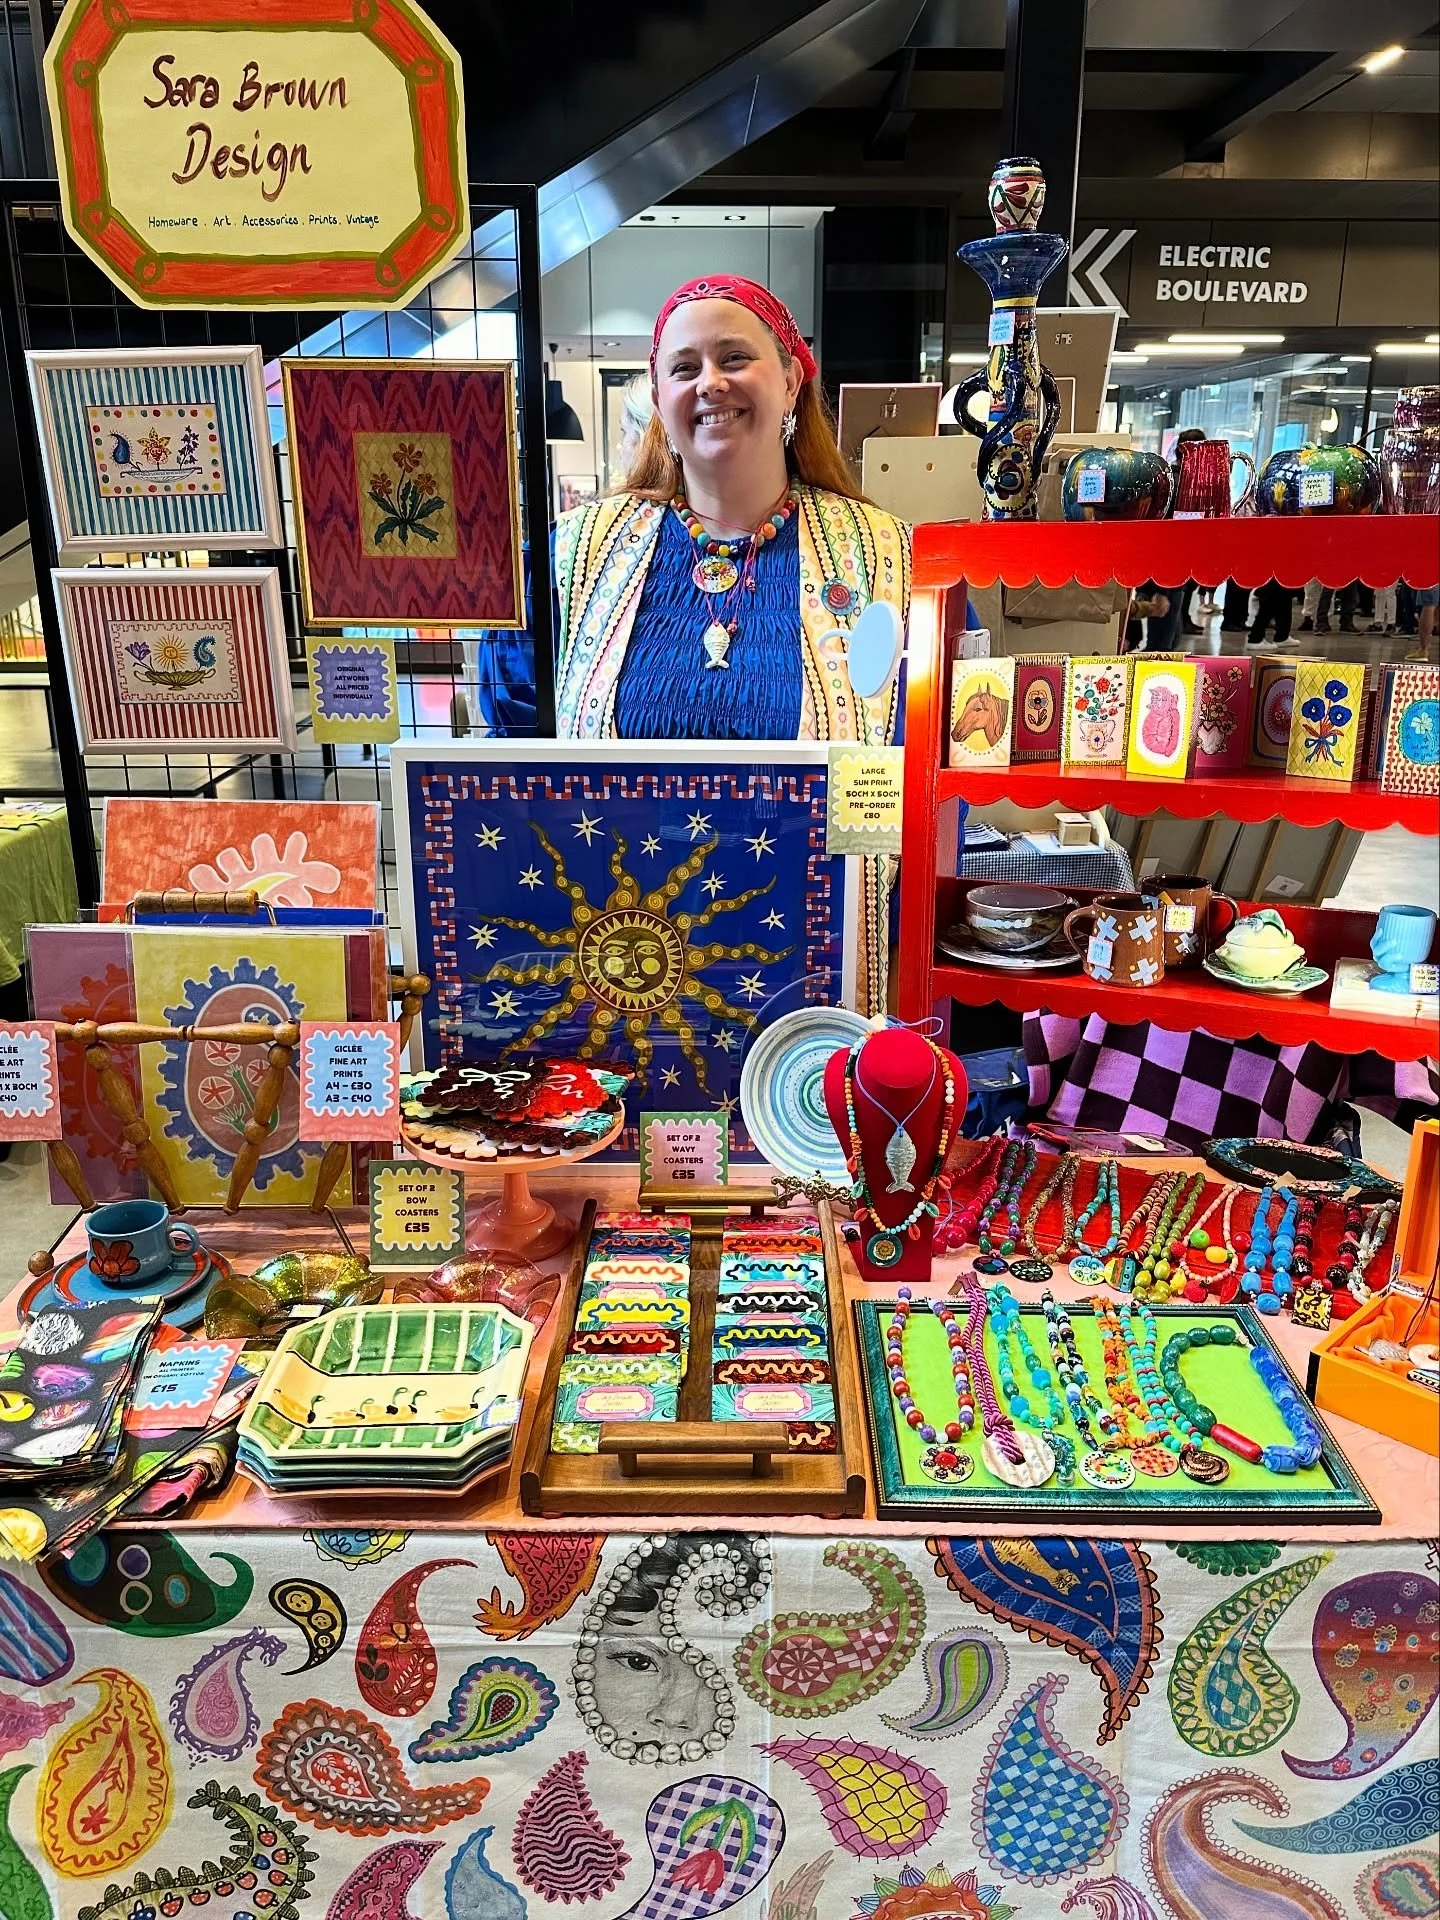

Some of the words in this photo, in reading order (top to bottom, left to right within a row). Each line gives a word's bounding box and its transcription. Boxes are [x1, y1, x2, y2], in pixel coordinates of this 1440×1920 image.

[144, 54, 220, 109] Sara
[232, 61, 351, 112] Brown
[171, 121, 313, 203] Design
[148, 216, 198, 228] Homeware
[212, 215, 232, 227] Art
[242, 213, 299, 227] Accessories
[308, 214, 338, 226] Prints
[346, 214, 380, 229] Vintage
[1159, 245, 1272, 269] ELECTRIC
[1156, 279, 1309, 304] BOULEVARD
[845, 790, 869, 798] 50CM
[877, 790, 900, 798] 50CM
[334, 1043, 363, 1053] GICLÉE
[7, 1058, 24, 1067] ART
[333, 1070, 364, 1078] PRINTS
[325, 1081, 340, 1090] A4
[351, 1081, 373, 1090] £30
[325, 1094, 340, 1103] A3
[351, 1094, 373, 1103] £40
[672, 1169, 696, 1180] £35
[398, 1184, 414, 1192] SET
[415, 1184, 428, 1192] OF
[429, 1184, 436, 1192] 2
[406, 1196, 428, 1204] BOW
[395, 1208, 439, 1217] COASTERS
[405, 1222, 430, 1233] £35
[159, 1359, 201, 1368] NAPKINS
[150, 1383, 179, 1394] £15
